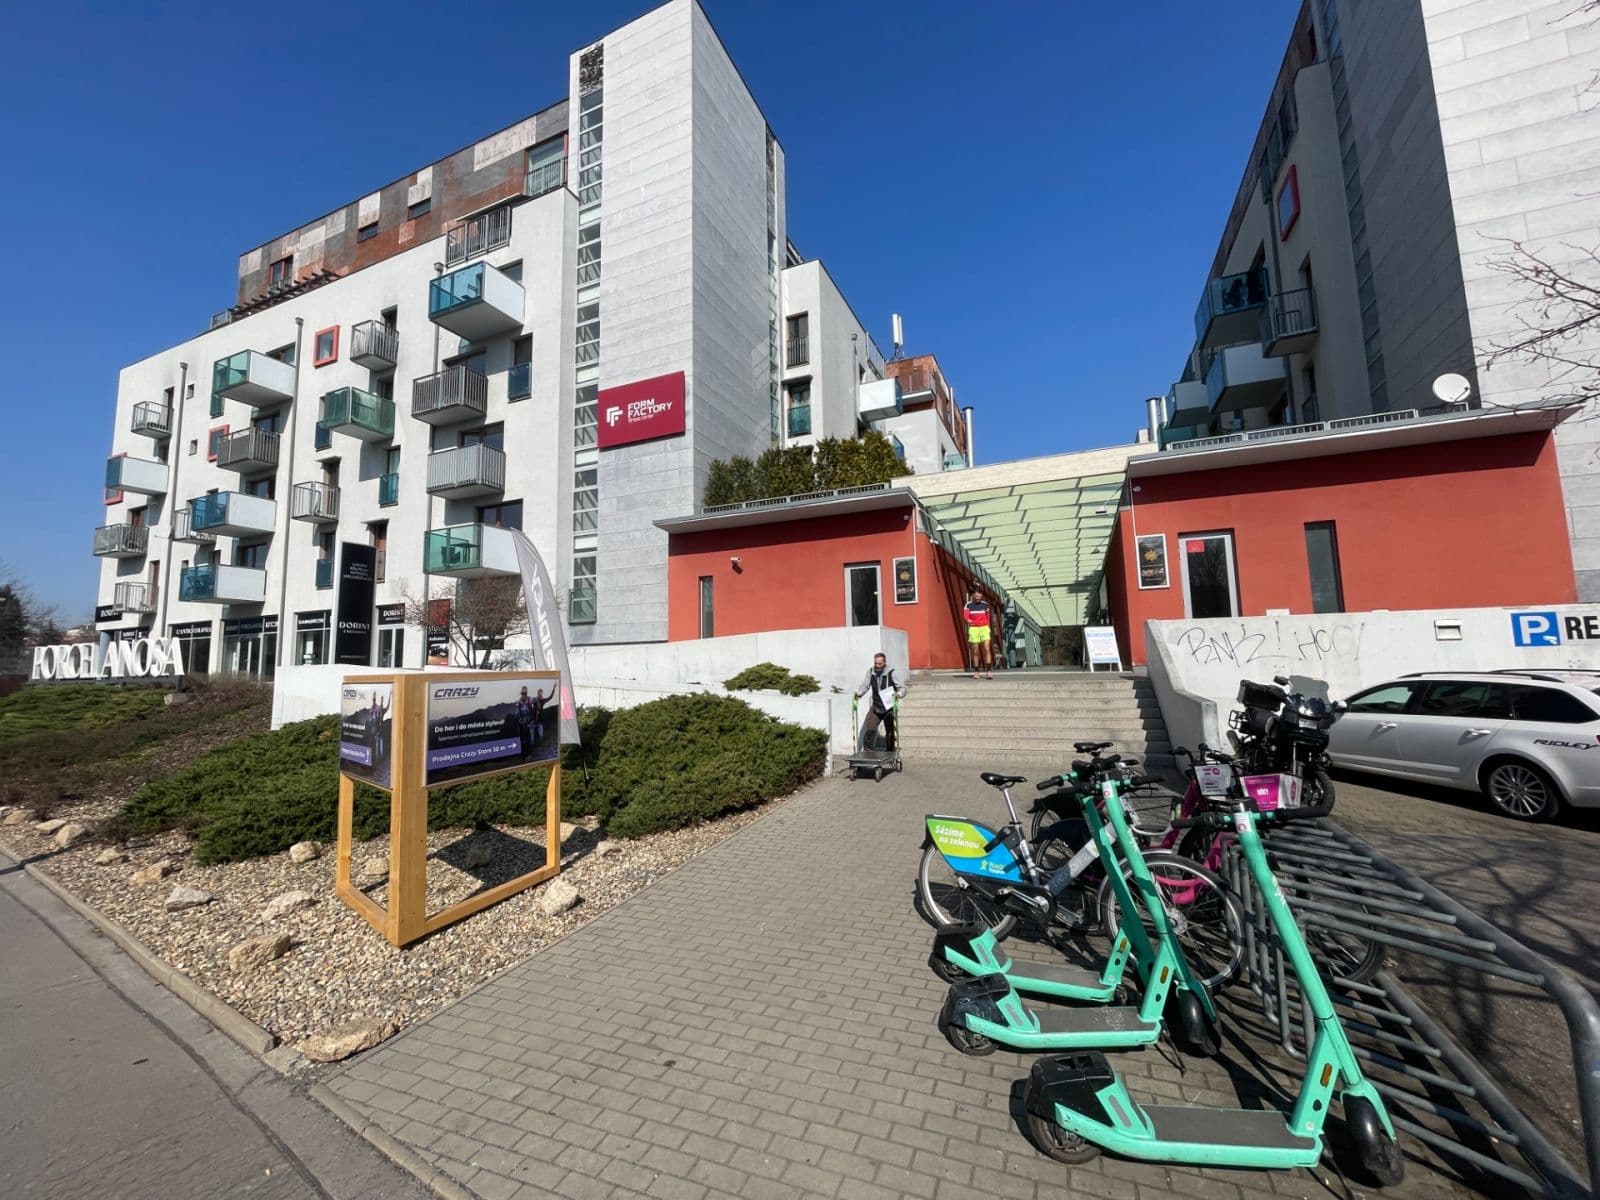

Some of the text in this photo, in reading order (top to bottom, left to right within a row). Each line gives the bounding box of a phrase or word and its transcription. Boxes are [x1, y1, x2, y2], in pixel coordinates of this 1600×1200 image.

[628, 398, 655, 410] FORM
[628, 402, 673, 417] FACTORY
[32, 637, 185, 679] PORCELANOSA
[434, 686, 481, 698] CRAZY
[459, 722, 467, 730] do
[1533, 738, 1600, 751] RIDLEY
[432, 754, 460, 763] Prodejna
[460, 750, 477, 758] Crazy
[477, 748, 493, 756] Store
[935, 825, 965, 838] Sázíme
[950, 838, 980, 849] zelenou
